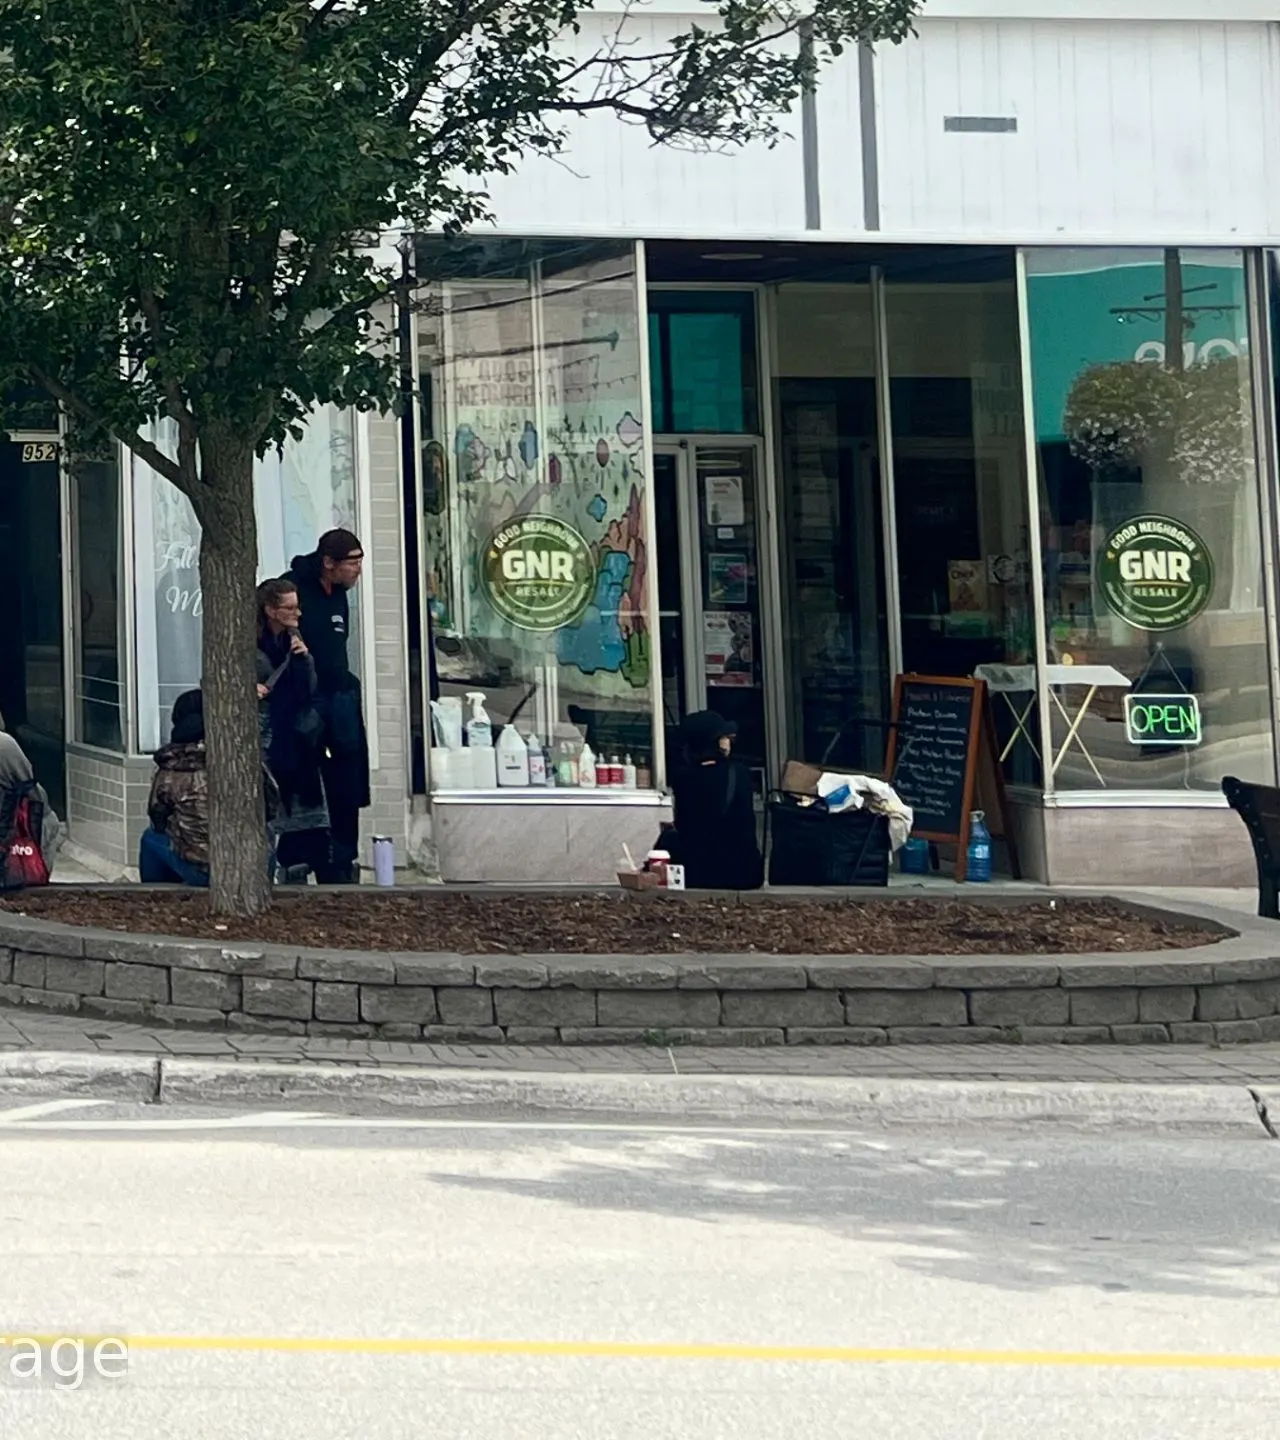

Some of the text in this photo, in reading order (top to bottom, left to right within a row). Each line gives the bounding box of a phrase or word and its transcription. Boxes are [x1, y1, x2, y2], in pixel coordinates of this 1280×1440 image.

[24, 444, 55, 461] 952
[493, 524, 521, 549] GOOD
[1110, 521, 1197, 552] GOOD NEIGHBOUR
[502, 549, 574, 582] GNR
[1119, 549, 1191, 582] GNR
[1133, 586, 1178, 597] RESALE
[1131, 705, 1196, 733] OPEN
